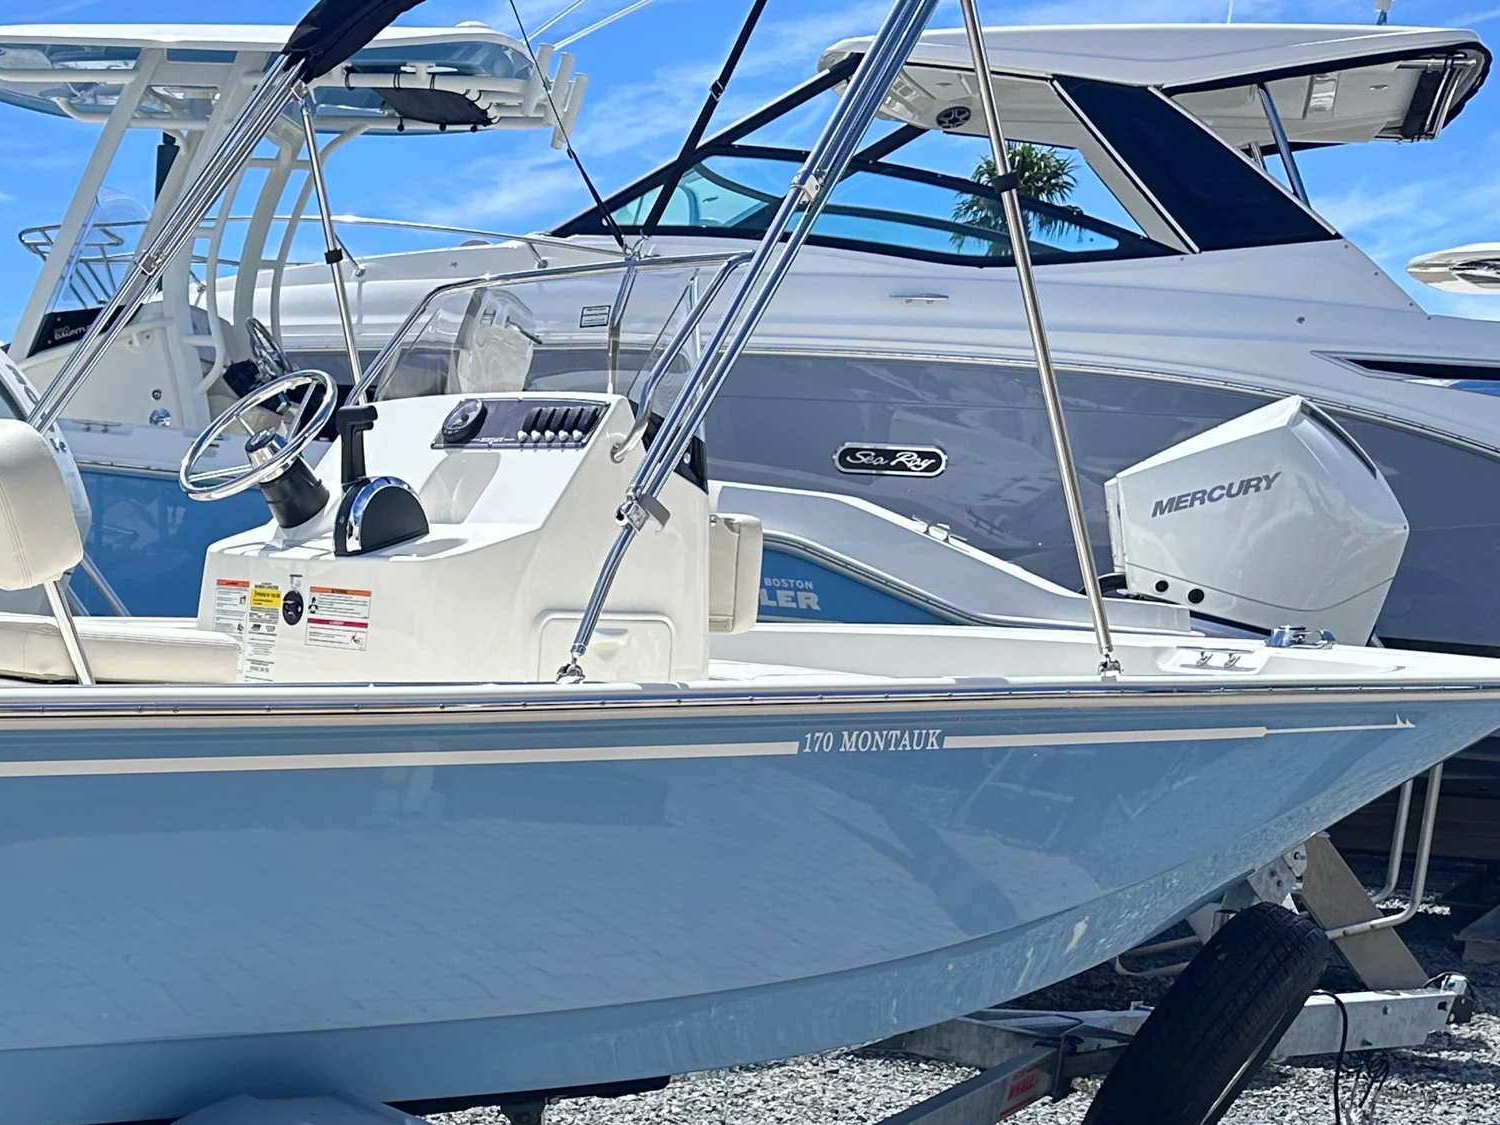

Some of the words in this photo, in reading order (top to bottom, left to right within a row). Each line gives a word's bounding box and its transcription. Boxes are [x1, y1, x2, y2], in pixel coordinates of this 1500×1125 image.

[845, 450, 888, 465] Sea
[890, 451, 936, 471] Ray
[1151, 471, 1282, 518] MERCURY
[763, 577, 814, 590] BOSTON
[759, 588, 822, 611] LER
[803, 732, 834, 753] 170
[839, 729, 942, 752] MONTAUK
